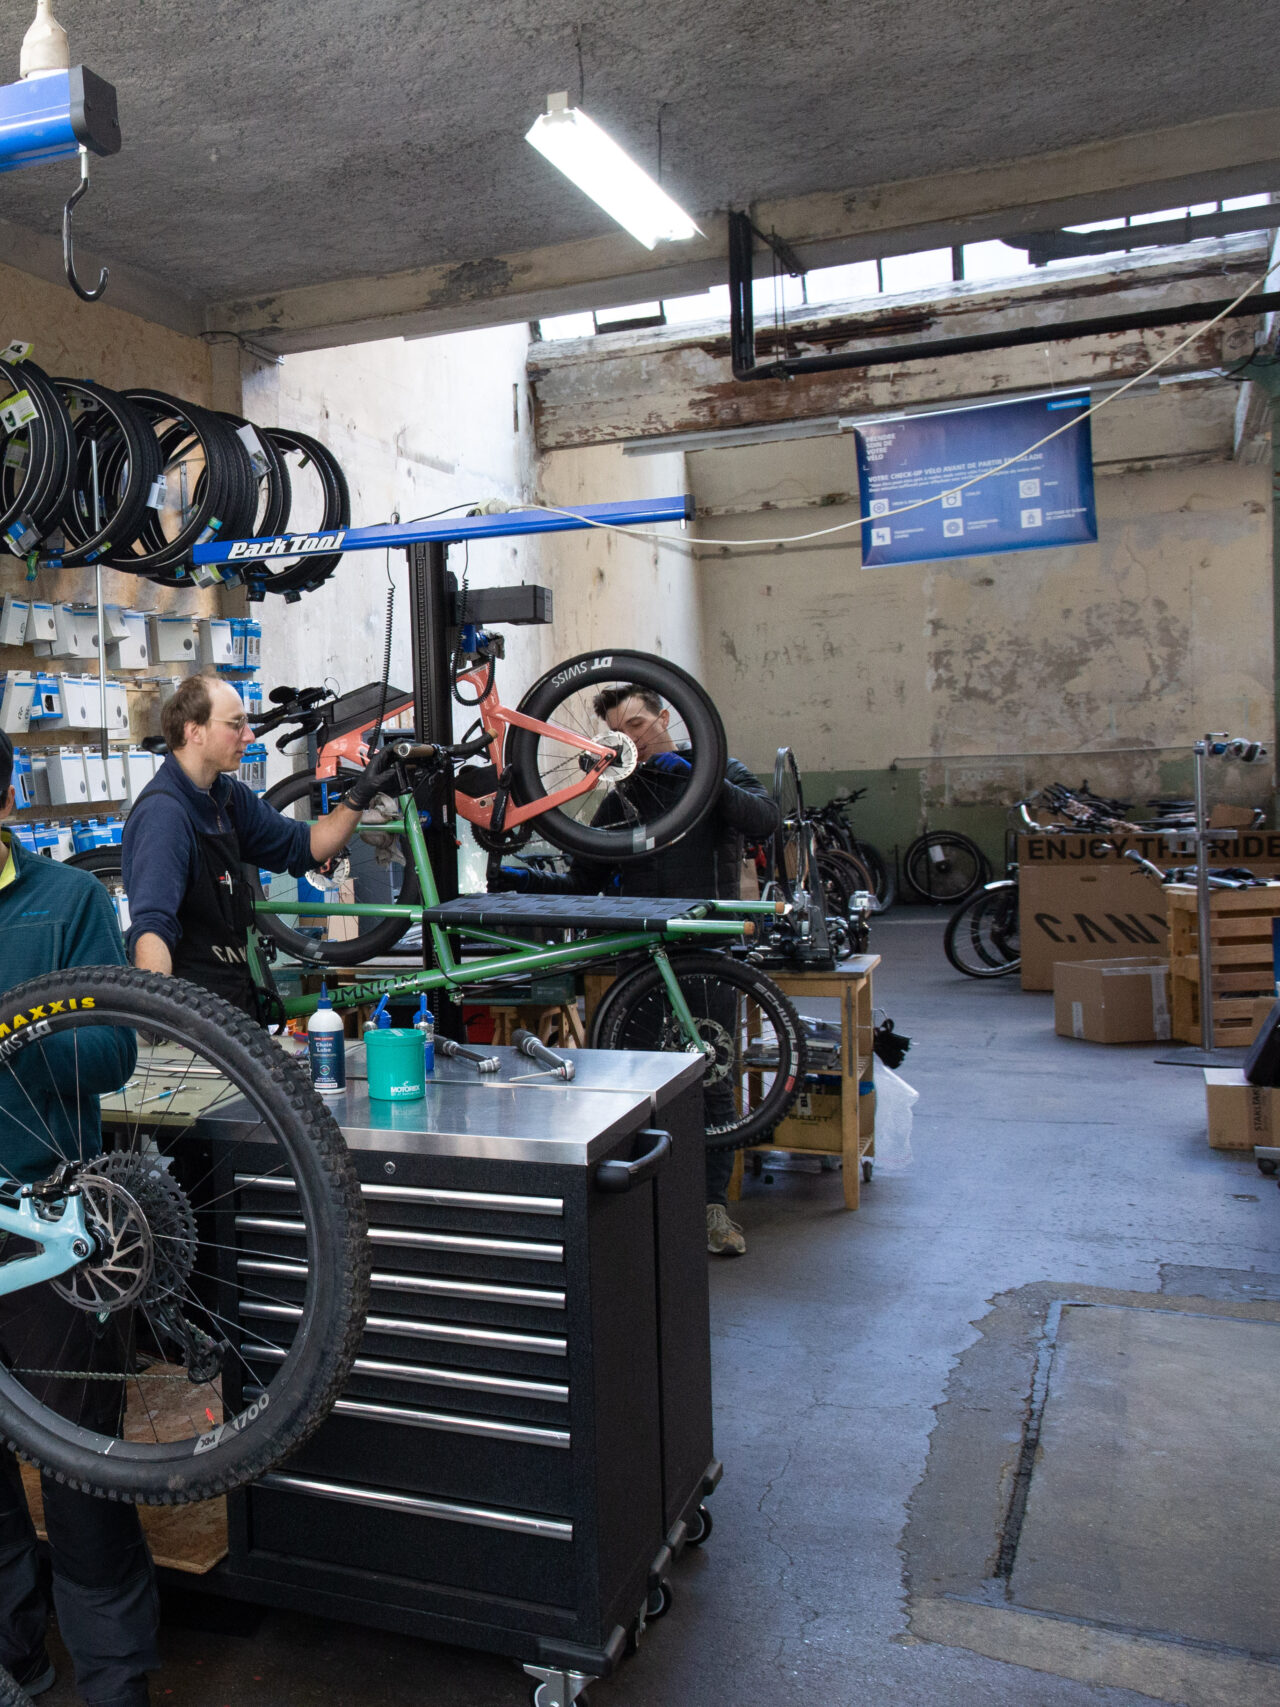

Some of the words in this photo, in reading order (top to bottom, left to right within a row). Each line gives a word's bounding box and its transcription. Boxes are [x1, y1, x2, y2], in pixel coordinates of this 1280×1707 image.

[867, 447, 888, 455] VOTRE
[867, 453, 884, 461] VÉLO
[868, 474, 889, 483] VOTRE
[890, 470, 923, 480] CHECK-UP
[924, 466, 941, 475] VÉLO
[943, 463, 966, 472] AVANT
[978, 459, 1003, 467] PARTIR
[228, 538, 286, 560] Park
[289, 531, 346, 553] Tool
[551, 661, 588, 688] SWISS
[590, 656, 613, 670] DT
[1028, 838, 1129, 861] ENJOY
[1218, 836, 1280, 858] RIDE
[26, 1019, 52, 1042] DT
[753, 982, 799, 1077] SCHWALBE
[390, 1085, 421, 1093] MOTOREX
[232, 1393, 270, 1431] 1700
[200, 1434, 216, 1448] XM
